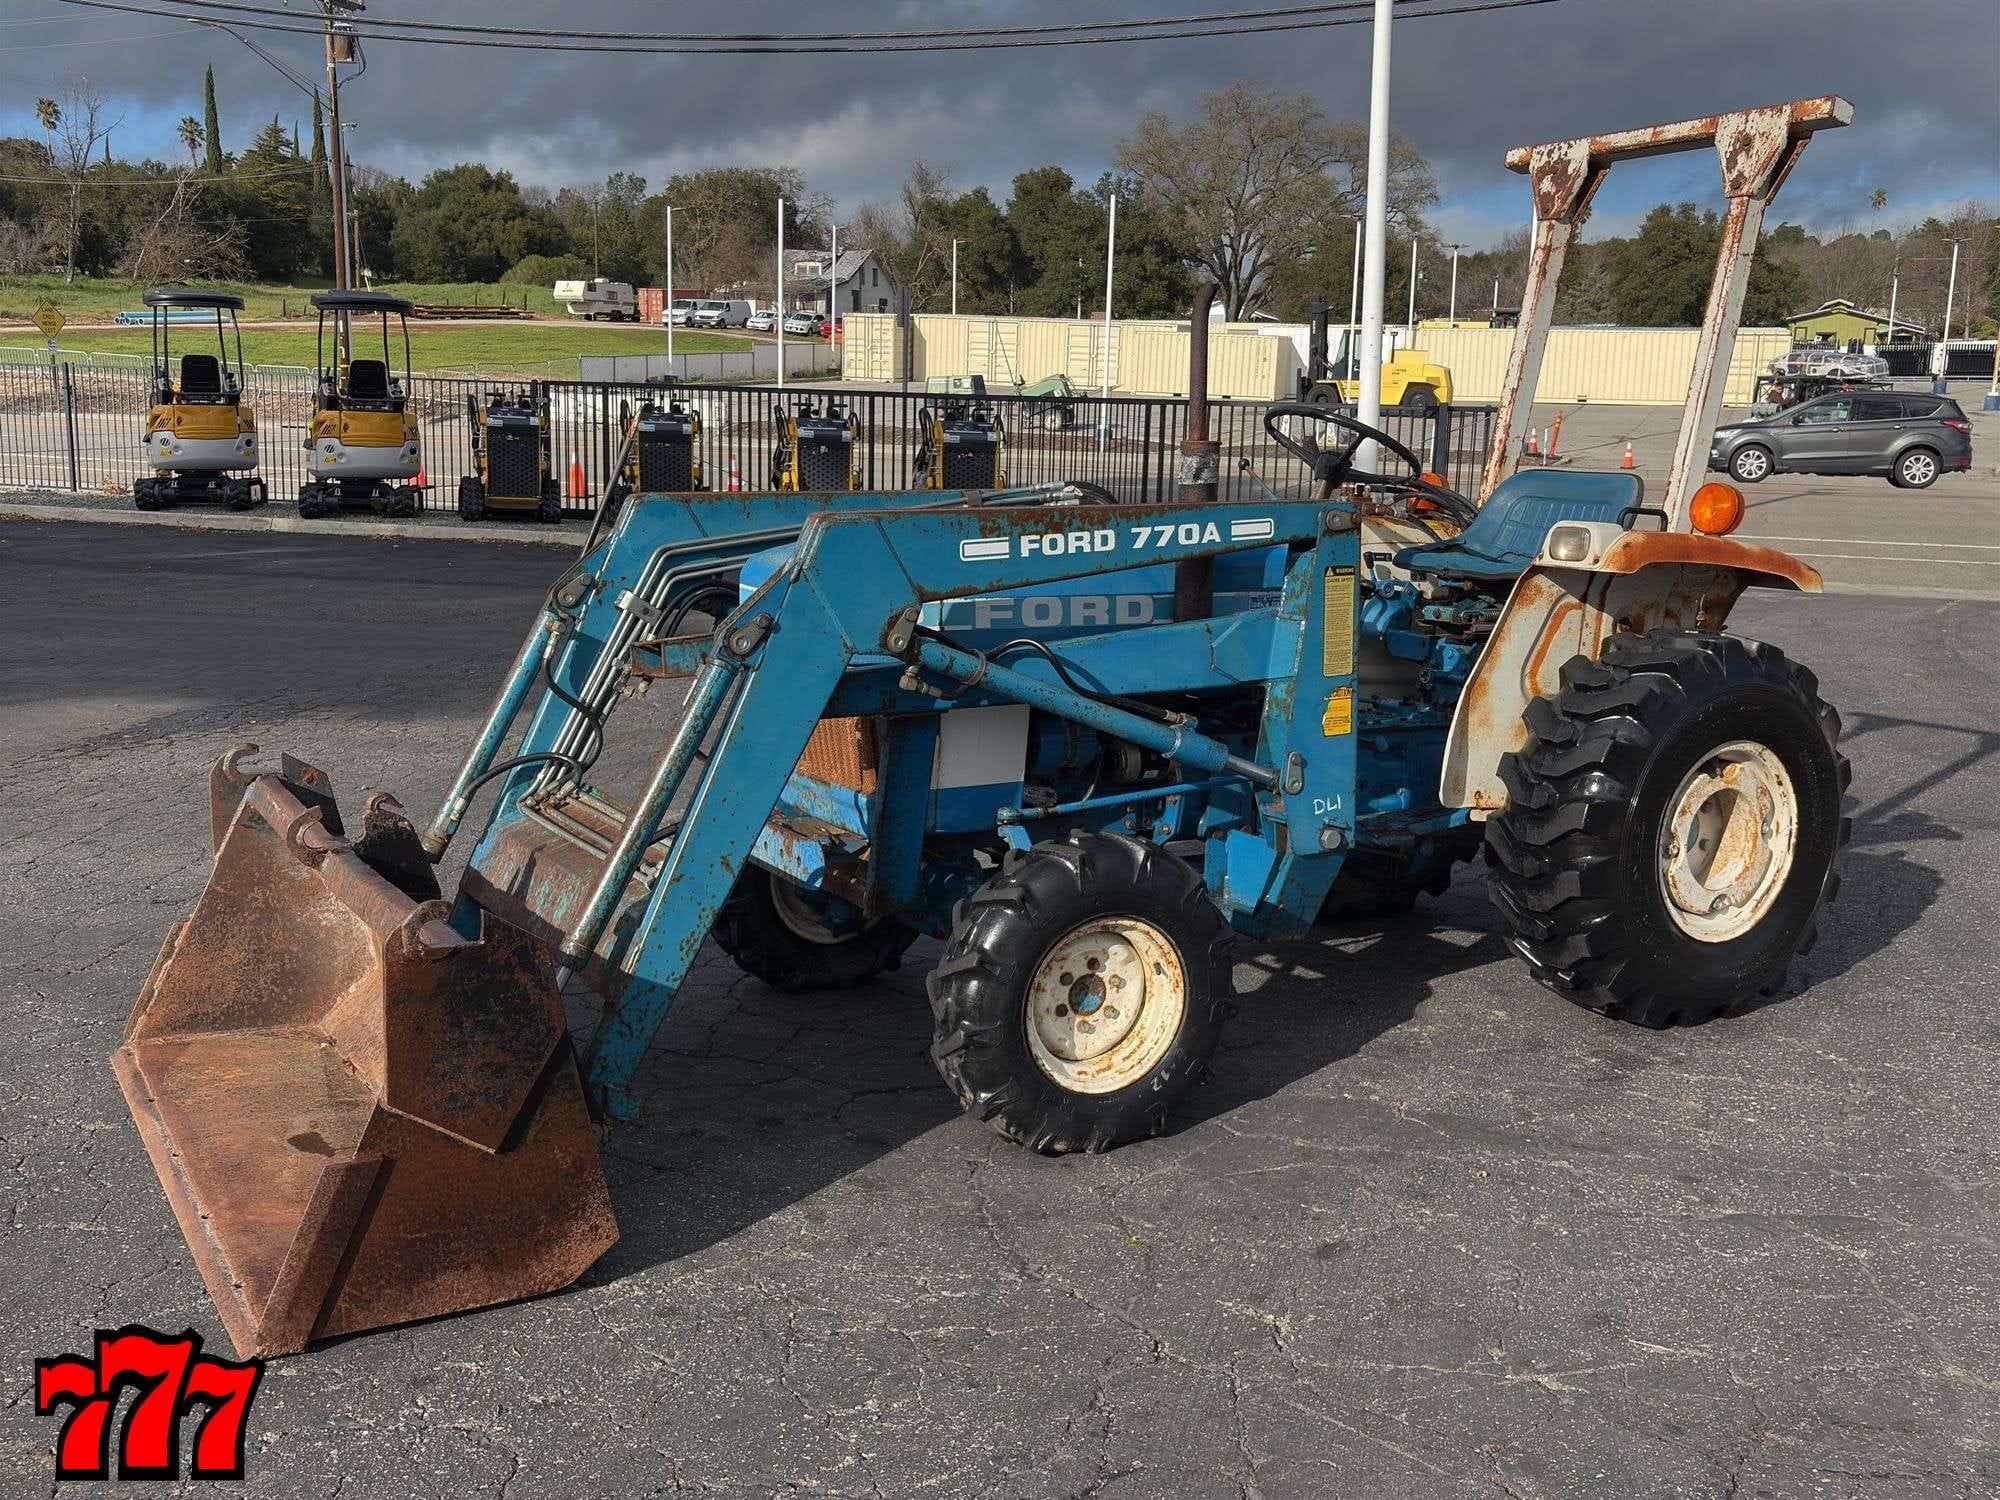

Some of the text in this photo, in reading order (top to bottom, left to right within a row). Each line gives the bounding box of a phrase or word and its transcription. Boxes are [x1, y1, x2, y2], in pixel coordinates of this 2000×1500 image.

[1020, 522, 1222, 558] FORD 770A
[975, 595, 1155, 629] FORD
